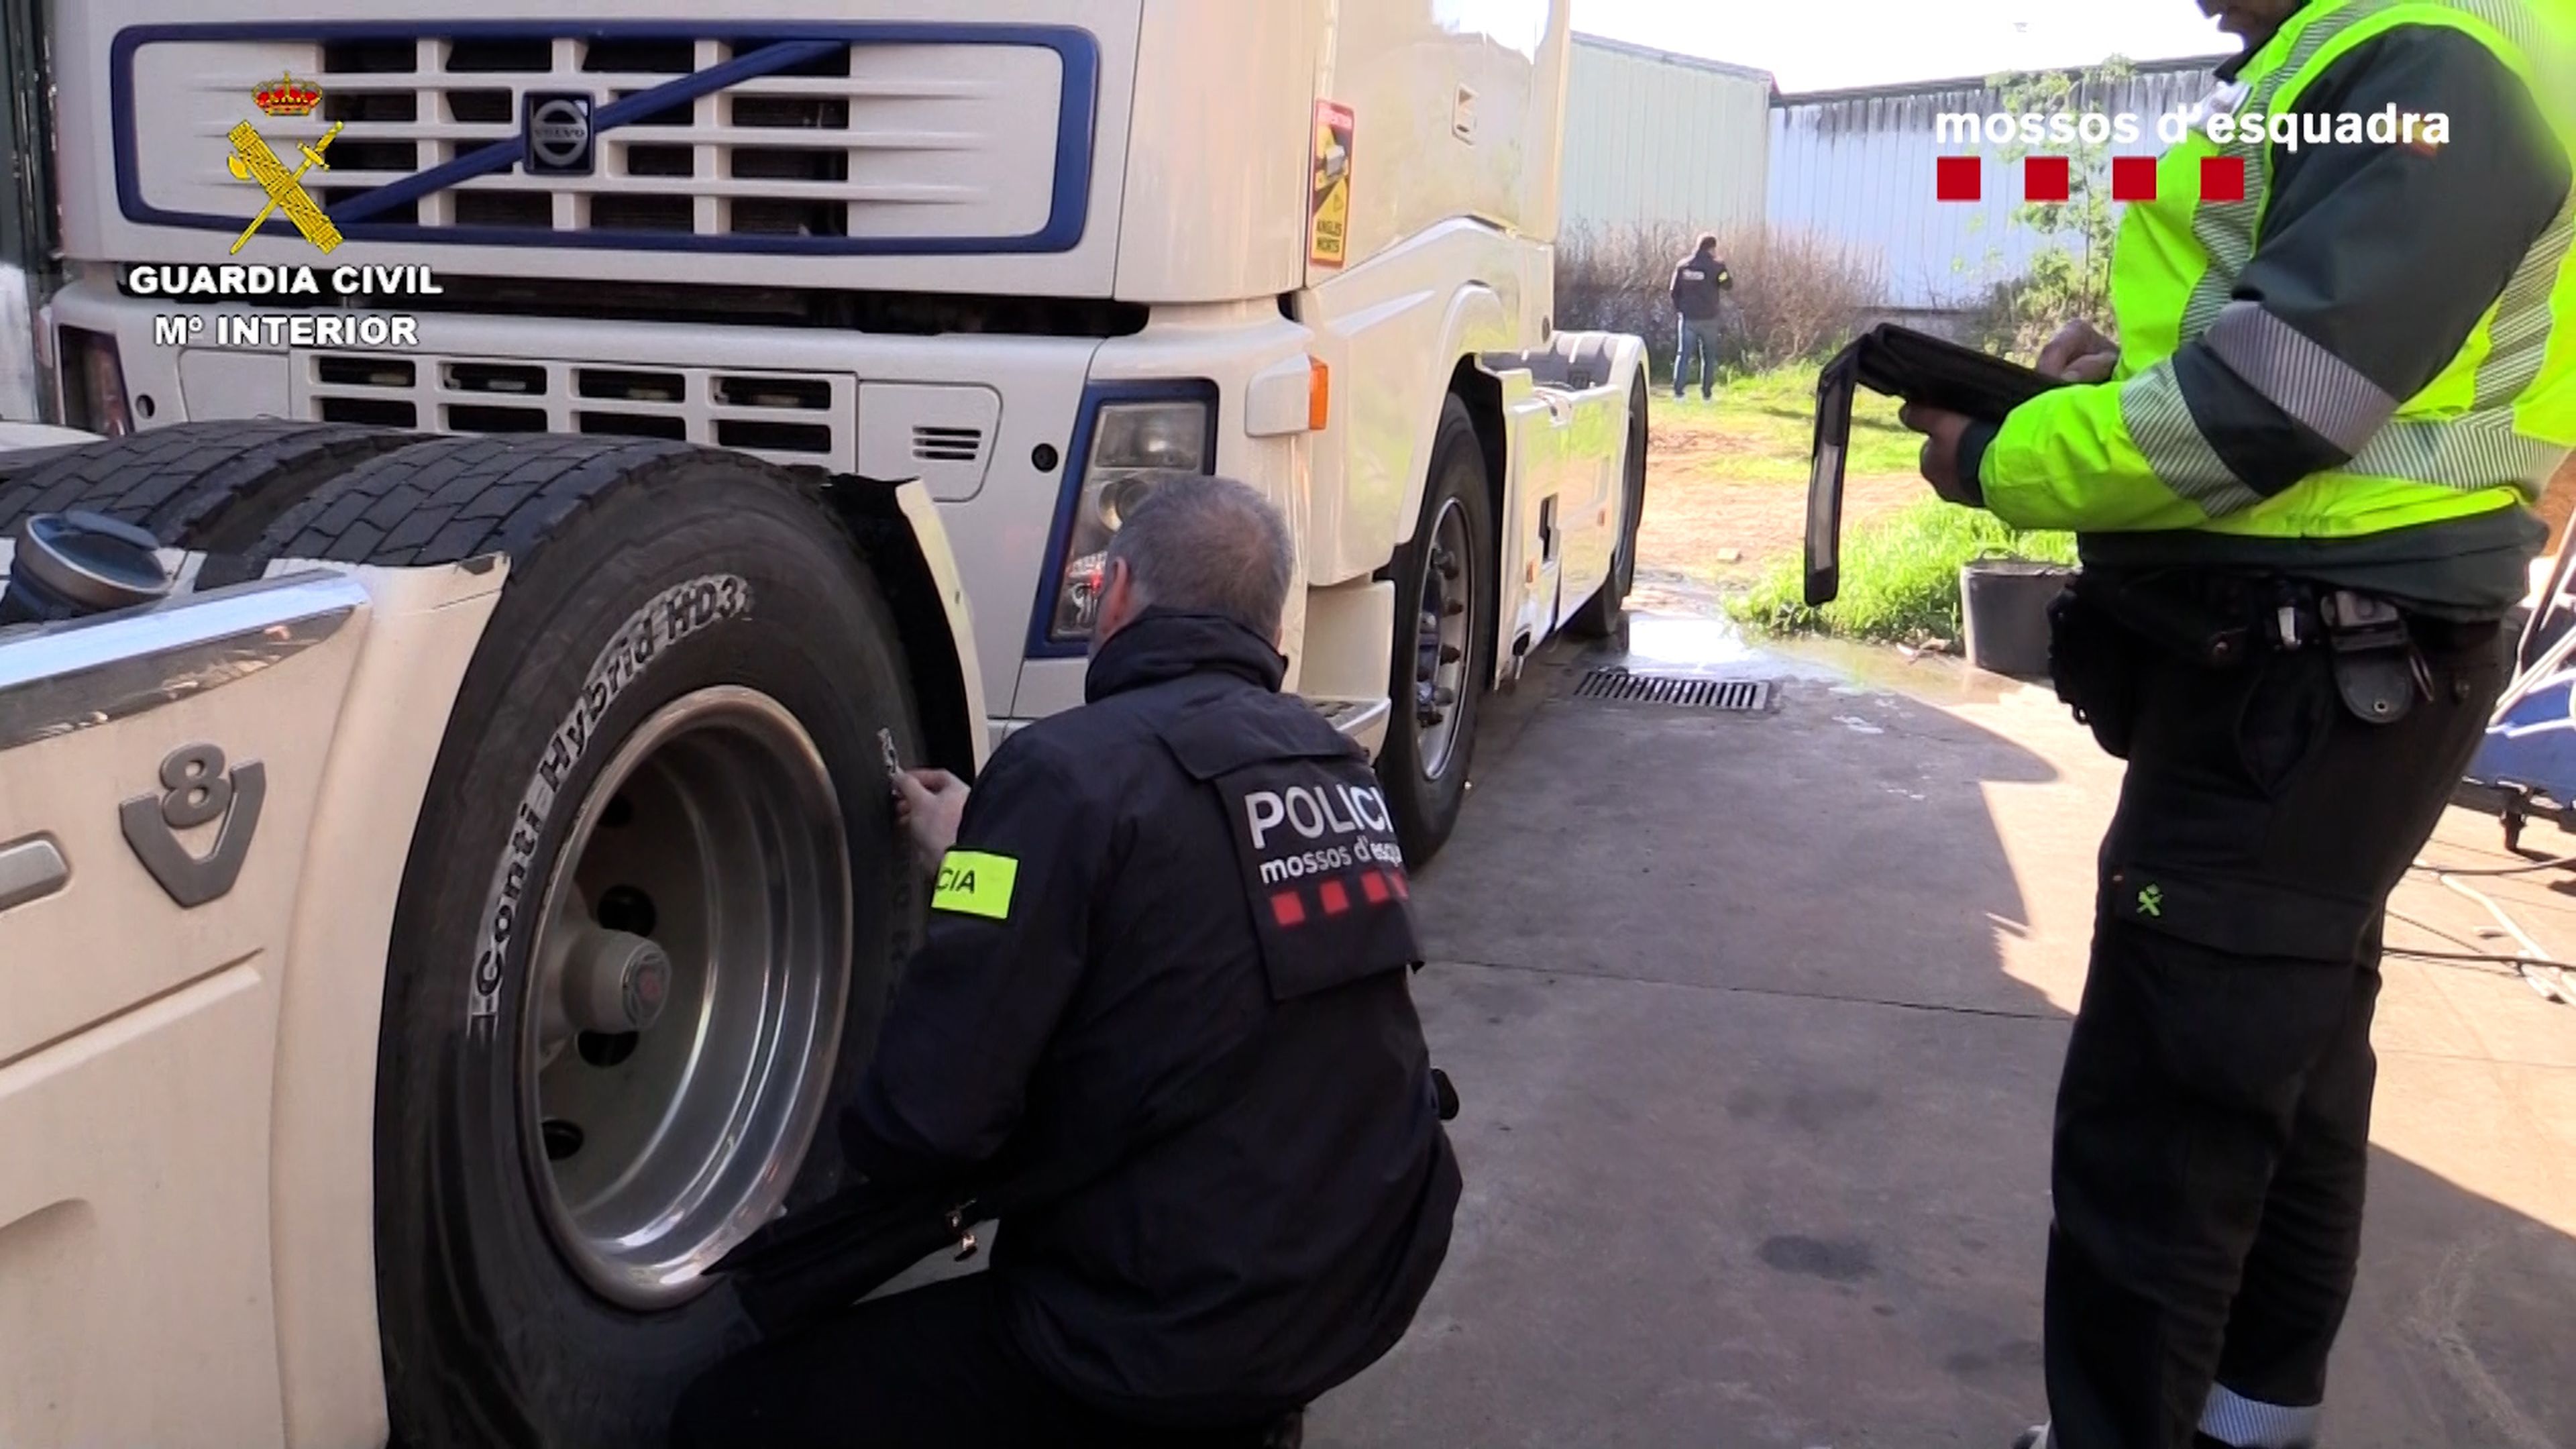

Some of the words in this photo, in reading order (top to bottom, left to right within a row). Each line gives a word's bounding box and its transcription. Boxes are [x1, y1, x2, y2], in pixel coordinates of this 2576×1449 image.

[476, 802, 541, 998] Conti
[539, 616, 656, 793] Hybrid
[1259, 845, 1353, 884] mossos
